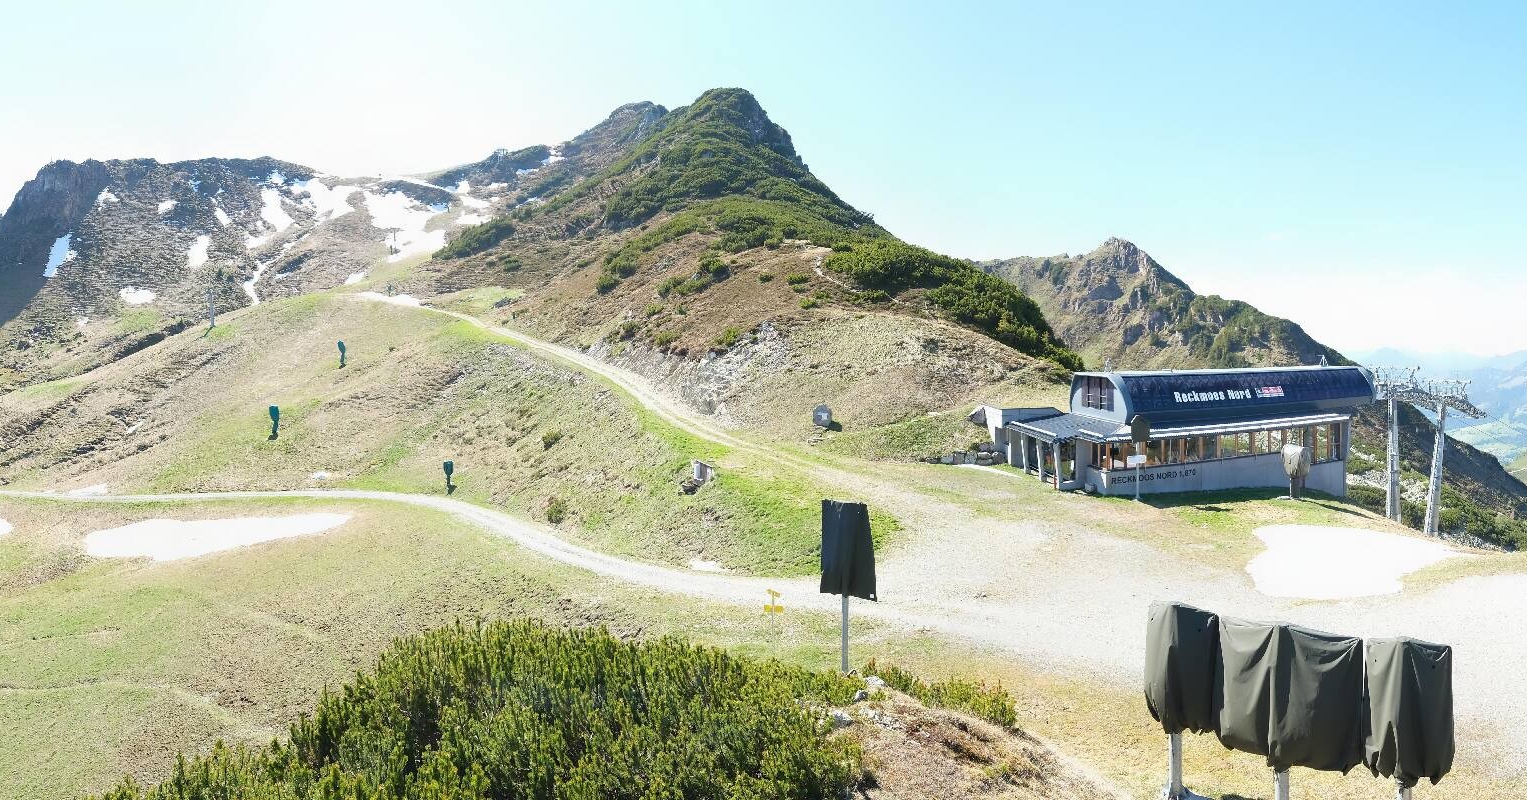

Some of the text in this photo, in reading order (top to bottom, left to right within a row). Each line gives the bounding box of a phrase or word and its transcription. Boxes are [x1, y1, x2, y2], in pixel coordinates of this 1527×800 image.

[1174, 391, 1225, 402] Reckmoos
[1227, 388, 1252, 400] Nord
[1156, 471, 1177, 480] NORD
